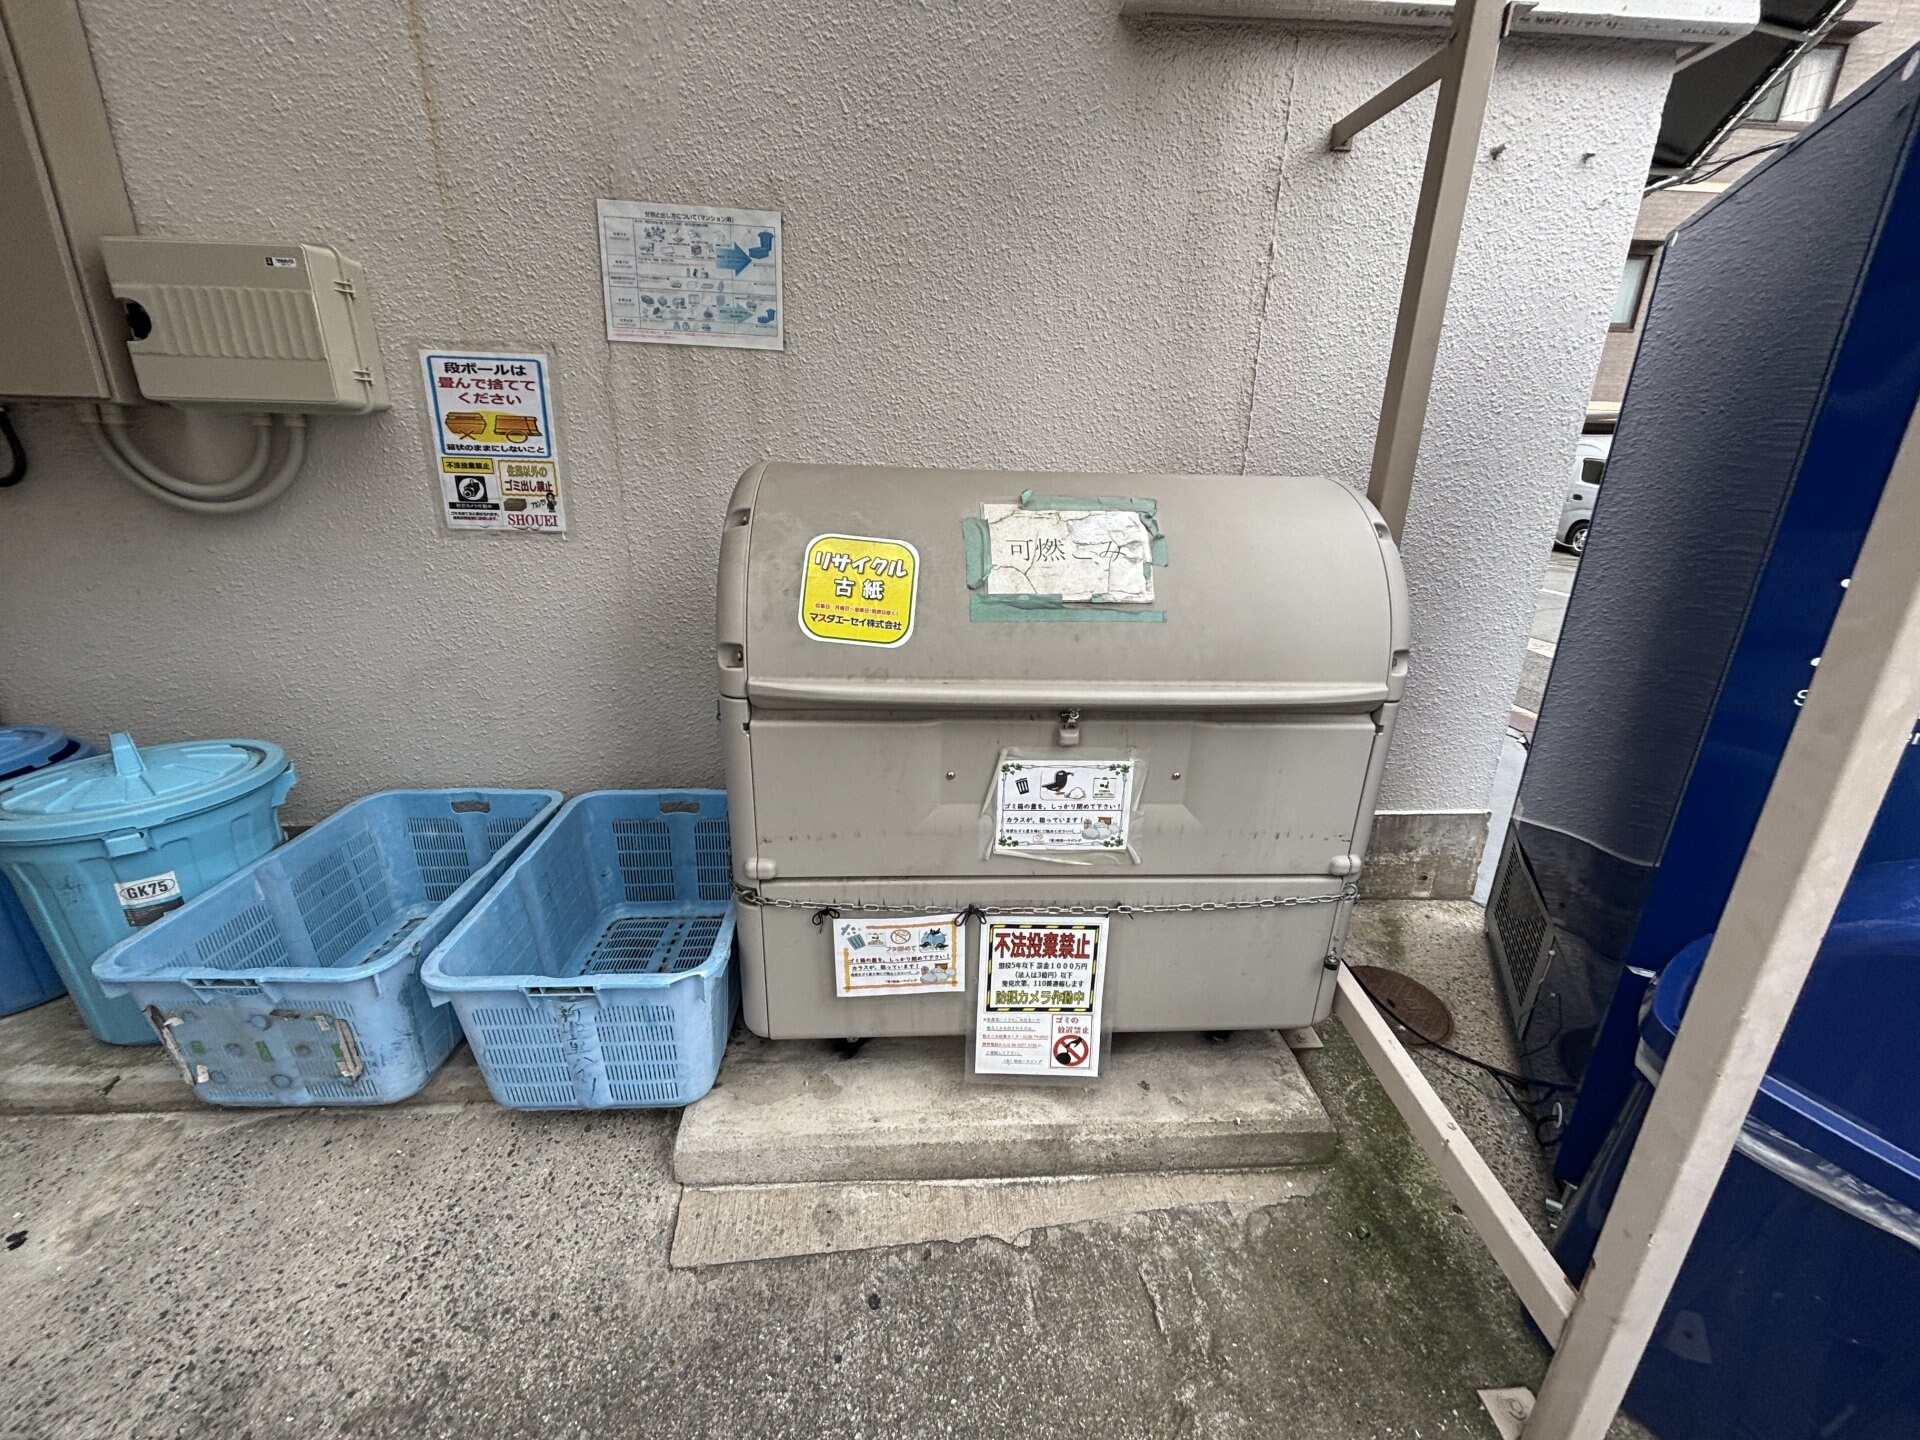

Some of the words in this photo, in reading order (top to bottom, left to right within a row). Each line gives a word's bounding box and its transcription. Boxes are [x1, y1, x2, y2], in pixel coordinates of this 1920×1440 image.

[444, 362, 527, 376] 段ボールは
[438, 376, 536, 392] 畳んで捨てて
[458, 393, 522, 405] ください
[446, 443, 545, 454] 箱状のままにしないこと
[446, 461, 491, 470] 不法投棄禁止
[504, 479, 554, 492] ゴミ出し禁止
[507, 514, 559, 527] SHOUEI
[815, 551, 909, 578] リサイクル
[833, 577, 885, 601] 古紙
[809, 612, 903, 631] マスダエーセイ株式会社
[127, 881, 169, 898] GK75
[994, 931, 1091, 960] 不法投棄禁止
[995, 990, 1085, 1005] 防犯カメラ作動中
[1055, 1016, 1079, 1025] ゴミの
[1058, 1026, 1090, 1035] 放置禁止
